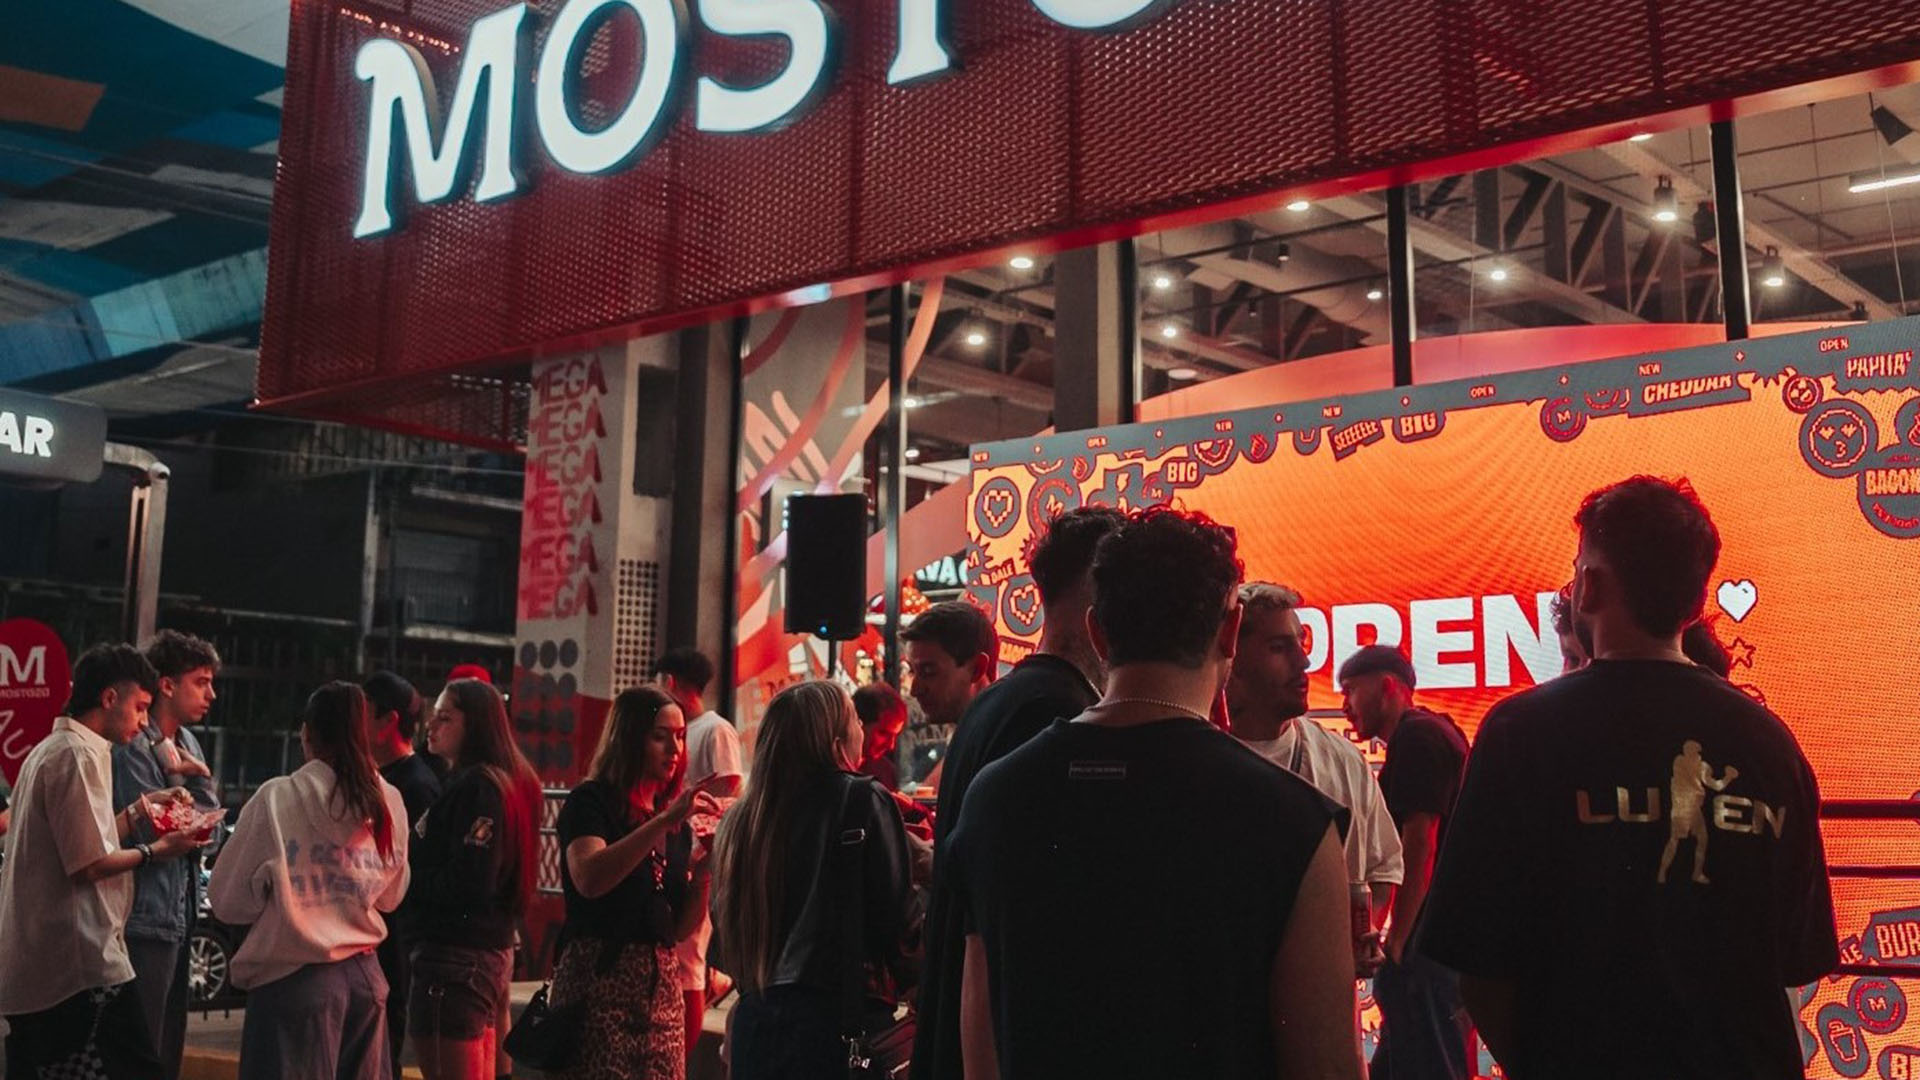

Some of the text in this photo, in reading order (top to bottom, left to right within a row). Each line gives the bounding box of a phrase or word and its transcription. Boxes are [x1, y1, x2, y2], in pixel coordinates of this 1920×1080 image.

[1819, 337, 1849, 352] OPEN
[1638, 362, 1662, 376] NEW
[1167, 461, 1198, 483] BIG
